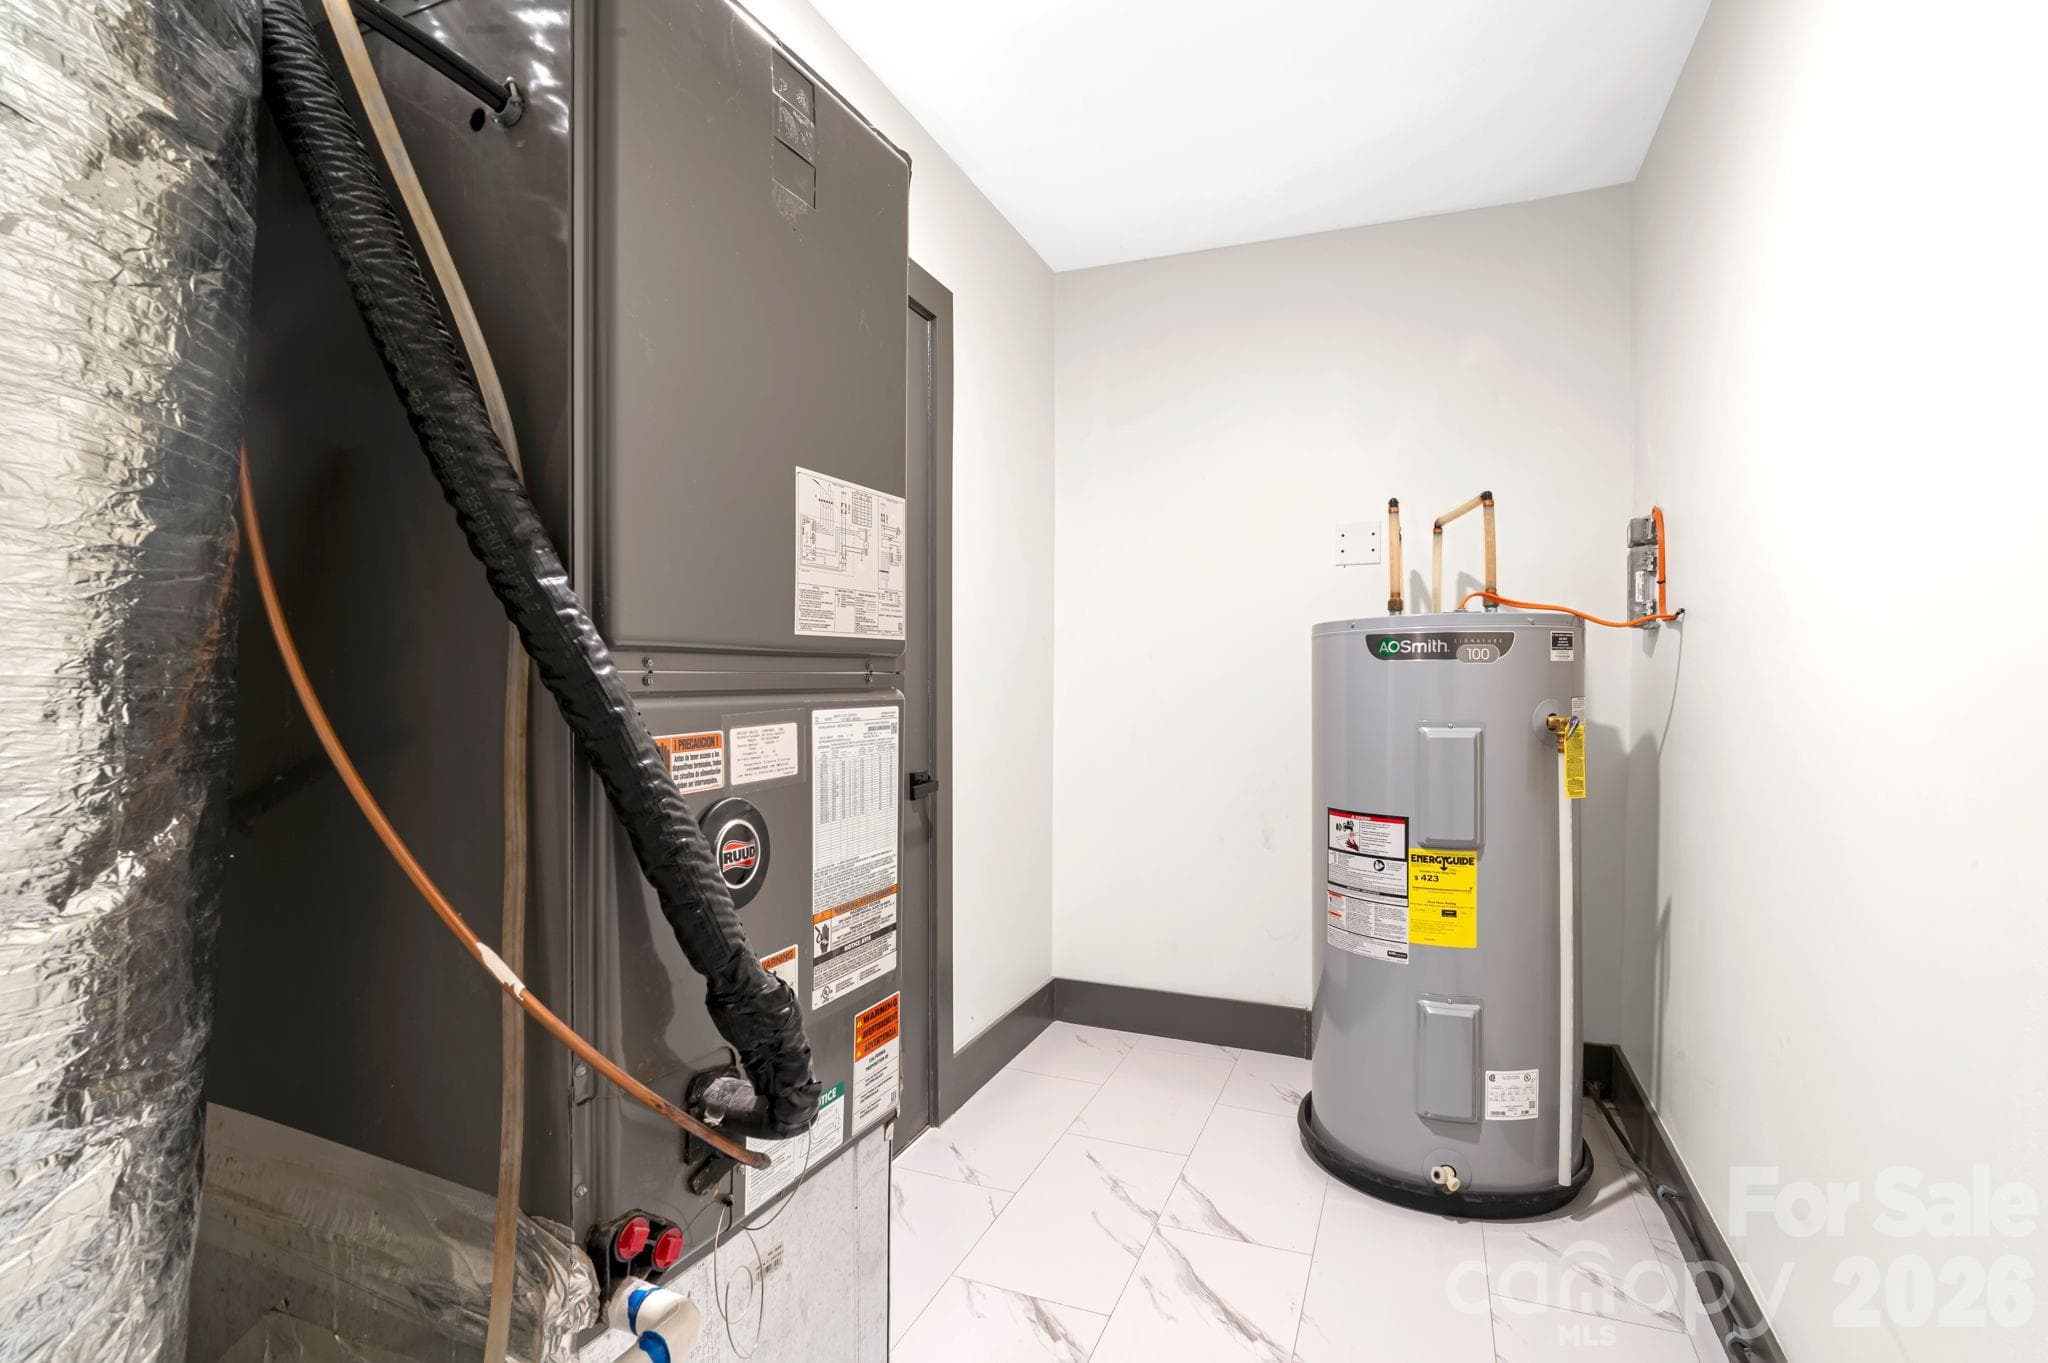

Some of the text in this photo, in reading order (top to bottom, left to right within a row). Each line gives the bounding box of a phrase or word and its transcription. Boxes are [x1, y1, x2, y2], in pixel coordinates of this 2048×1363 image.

[1466, 648, 1490, 661] 100
[678, 735, 715, 752] PRECAUCION
[723, 845, 756, 865] RUUD
[1410, 854, 1475, 867] ENERGYGUIDE
[1421, 874, 1440, 883] 423
[863, 998, 898, 1023] WARNING
